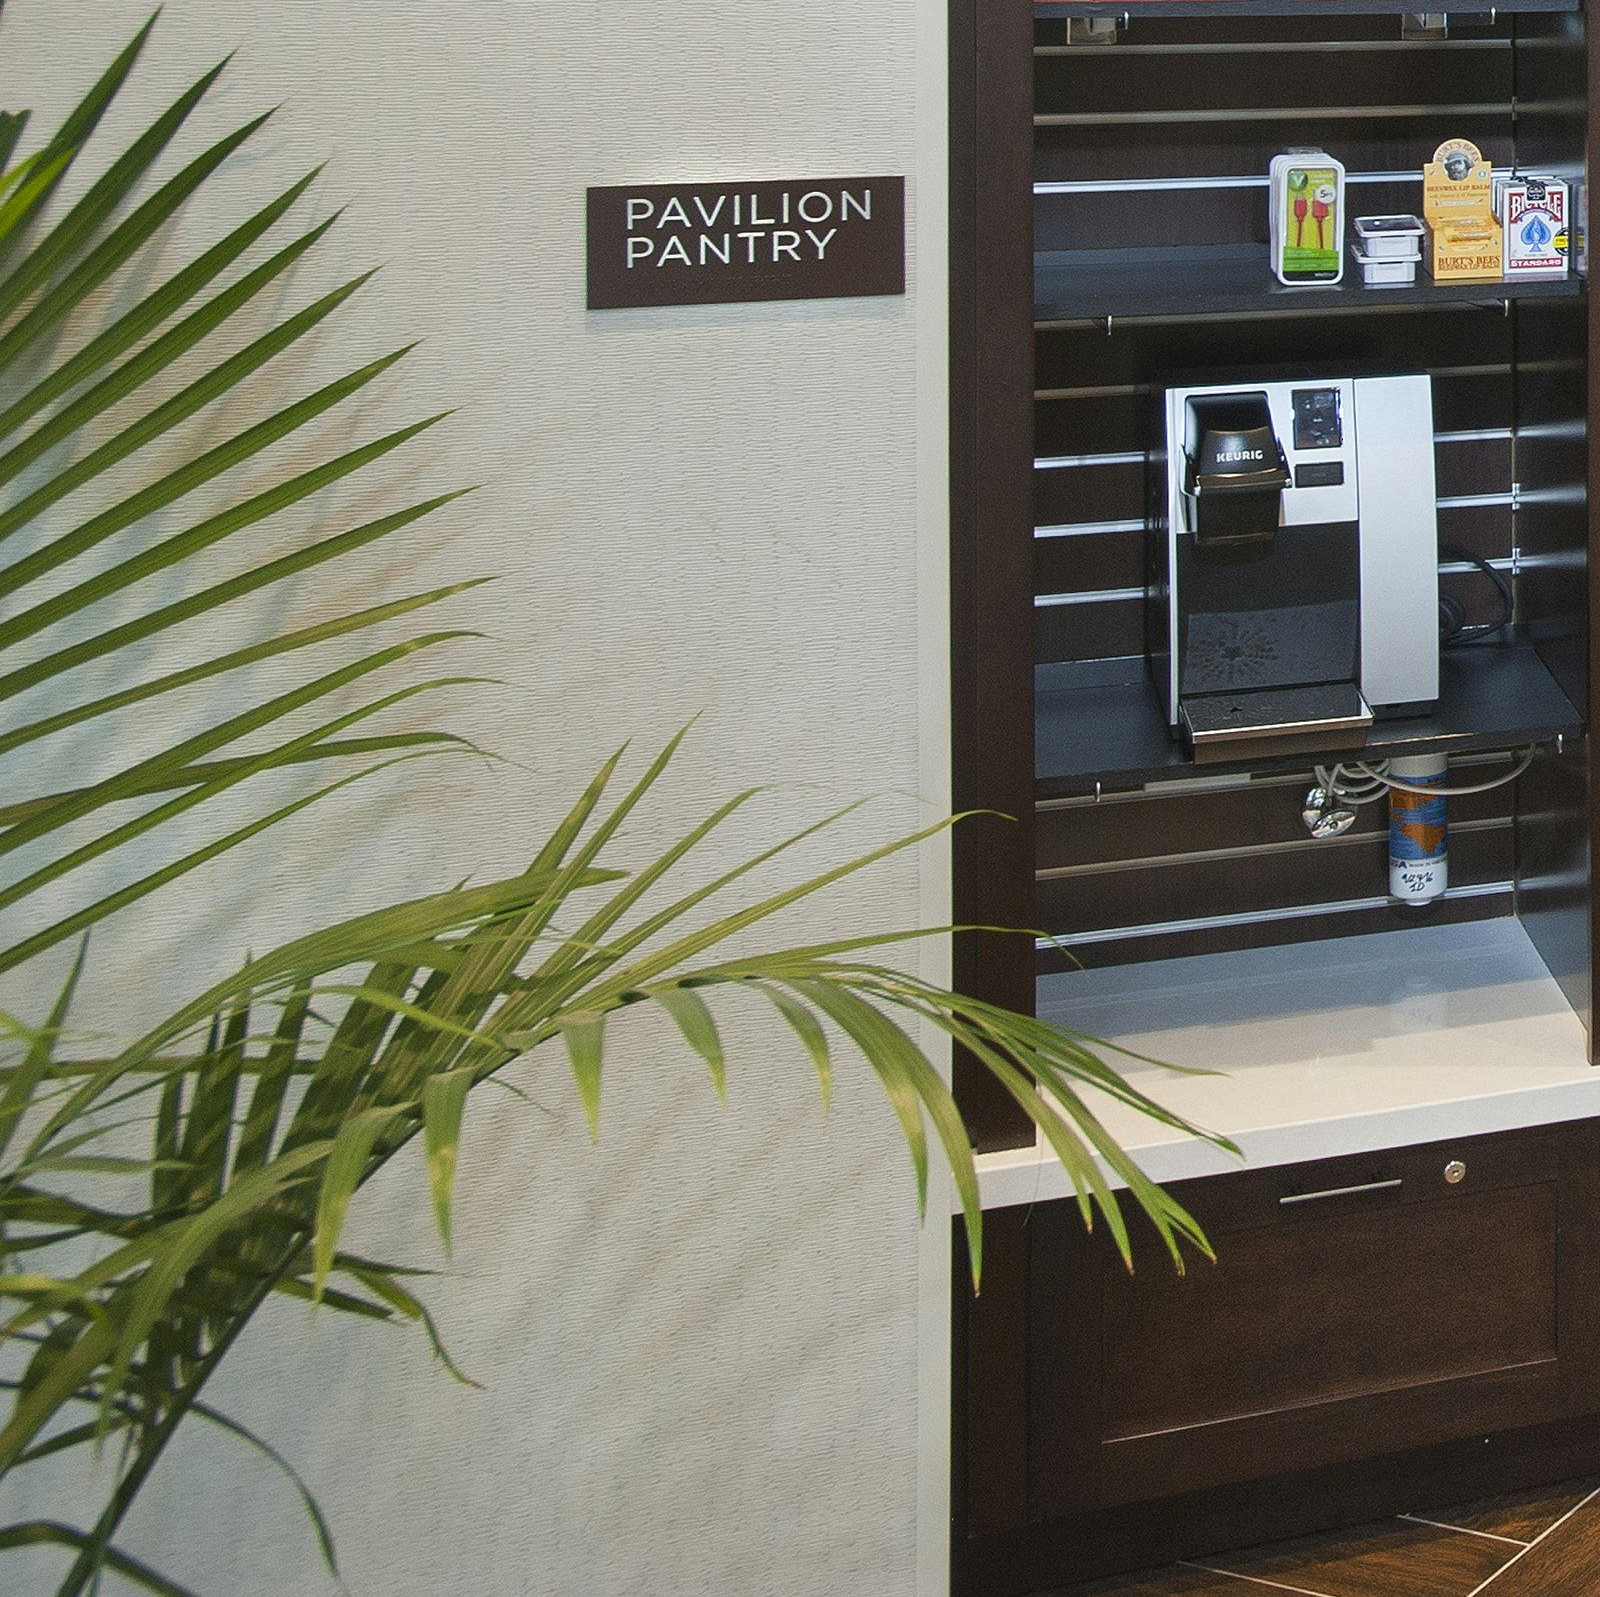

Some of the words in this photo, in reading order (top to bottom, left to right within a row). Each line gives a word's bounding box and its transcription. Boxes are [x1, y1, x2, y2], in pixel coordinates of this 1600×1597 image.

[626, 189, 872, 230] PAVILION
[626, 229, 838, 269] PANTRY
[1438, 256, 1474, 267] BURT'S
[1476, 255, 1501, 266] BEES
[1510, 259, 1562, 268] STANDARD
[1215, 448, 1264, 464] KEURIG
